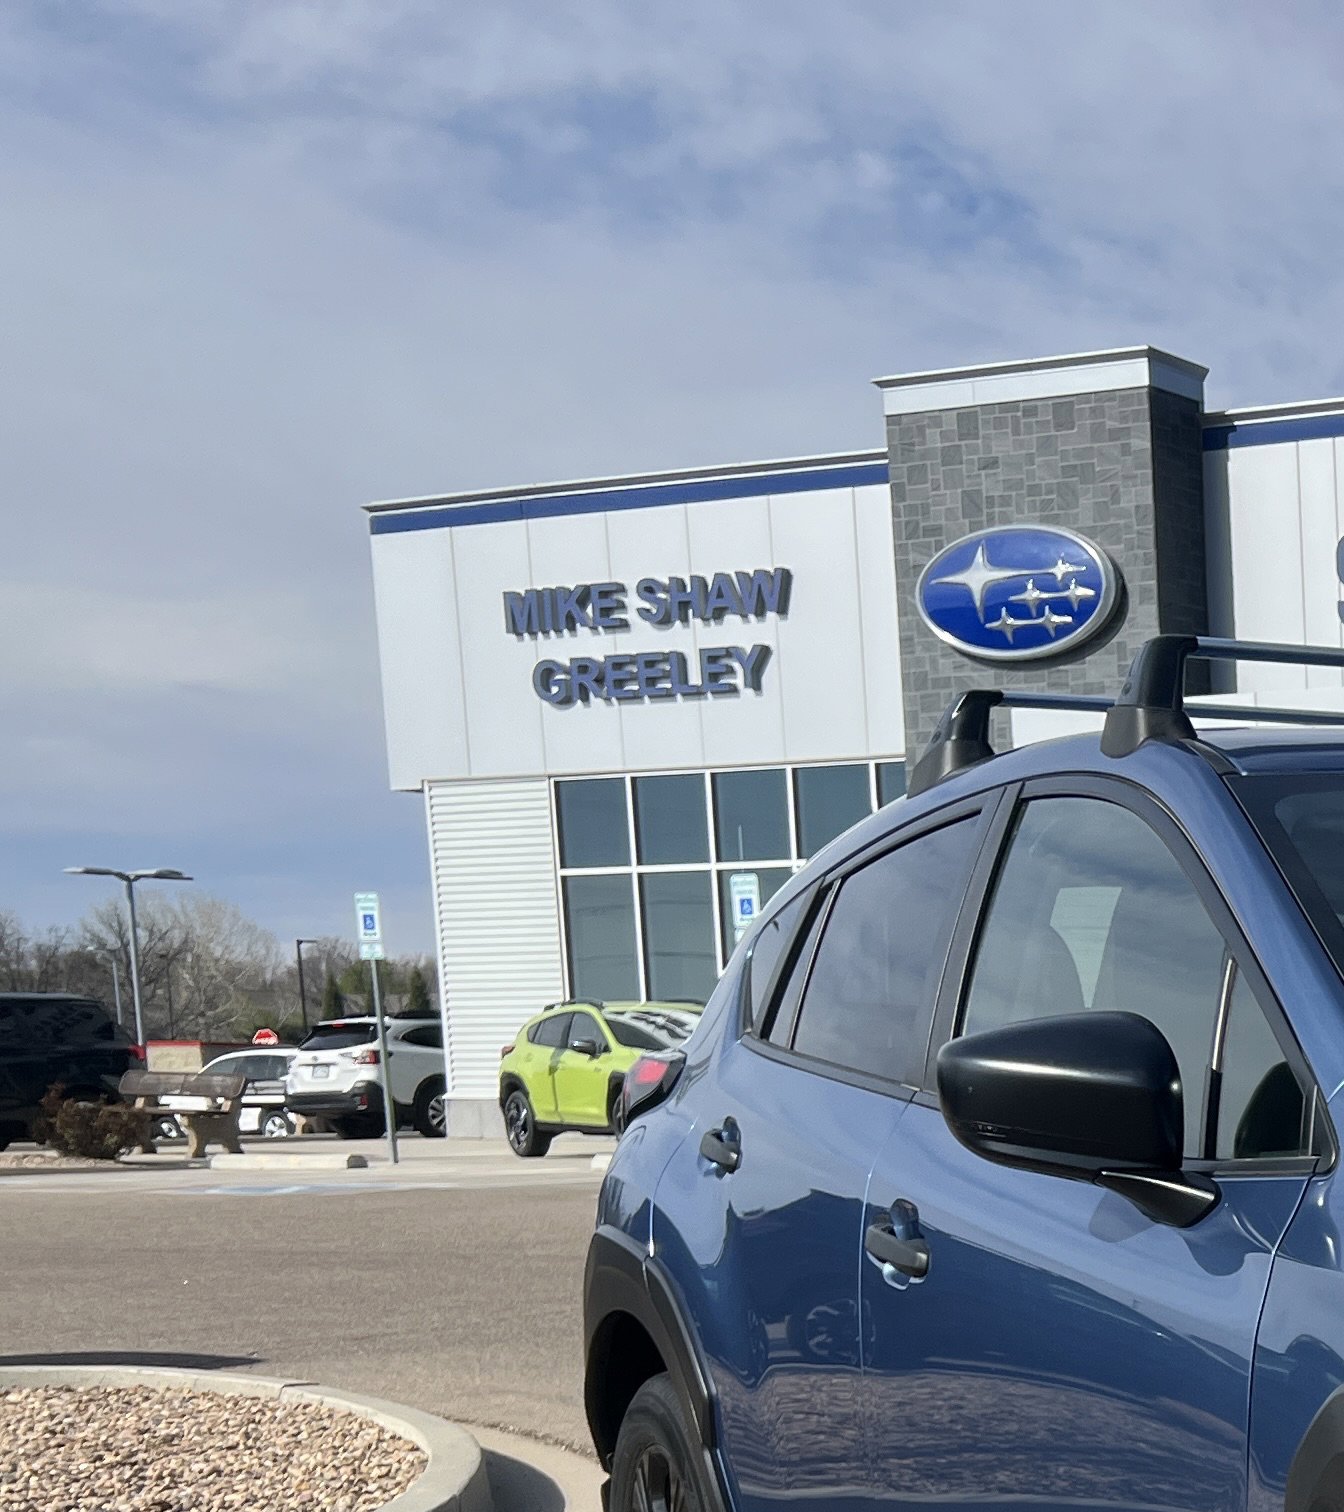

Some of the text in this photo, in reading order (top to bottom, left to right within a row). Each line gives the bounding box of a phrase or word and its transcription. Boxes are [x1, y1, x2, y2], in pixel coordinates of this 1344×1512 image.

[502, 567, 793, 641] MIKE SHAW
[532, 644, 773, 709] GREELEY
